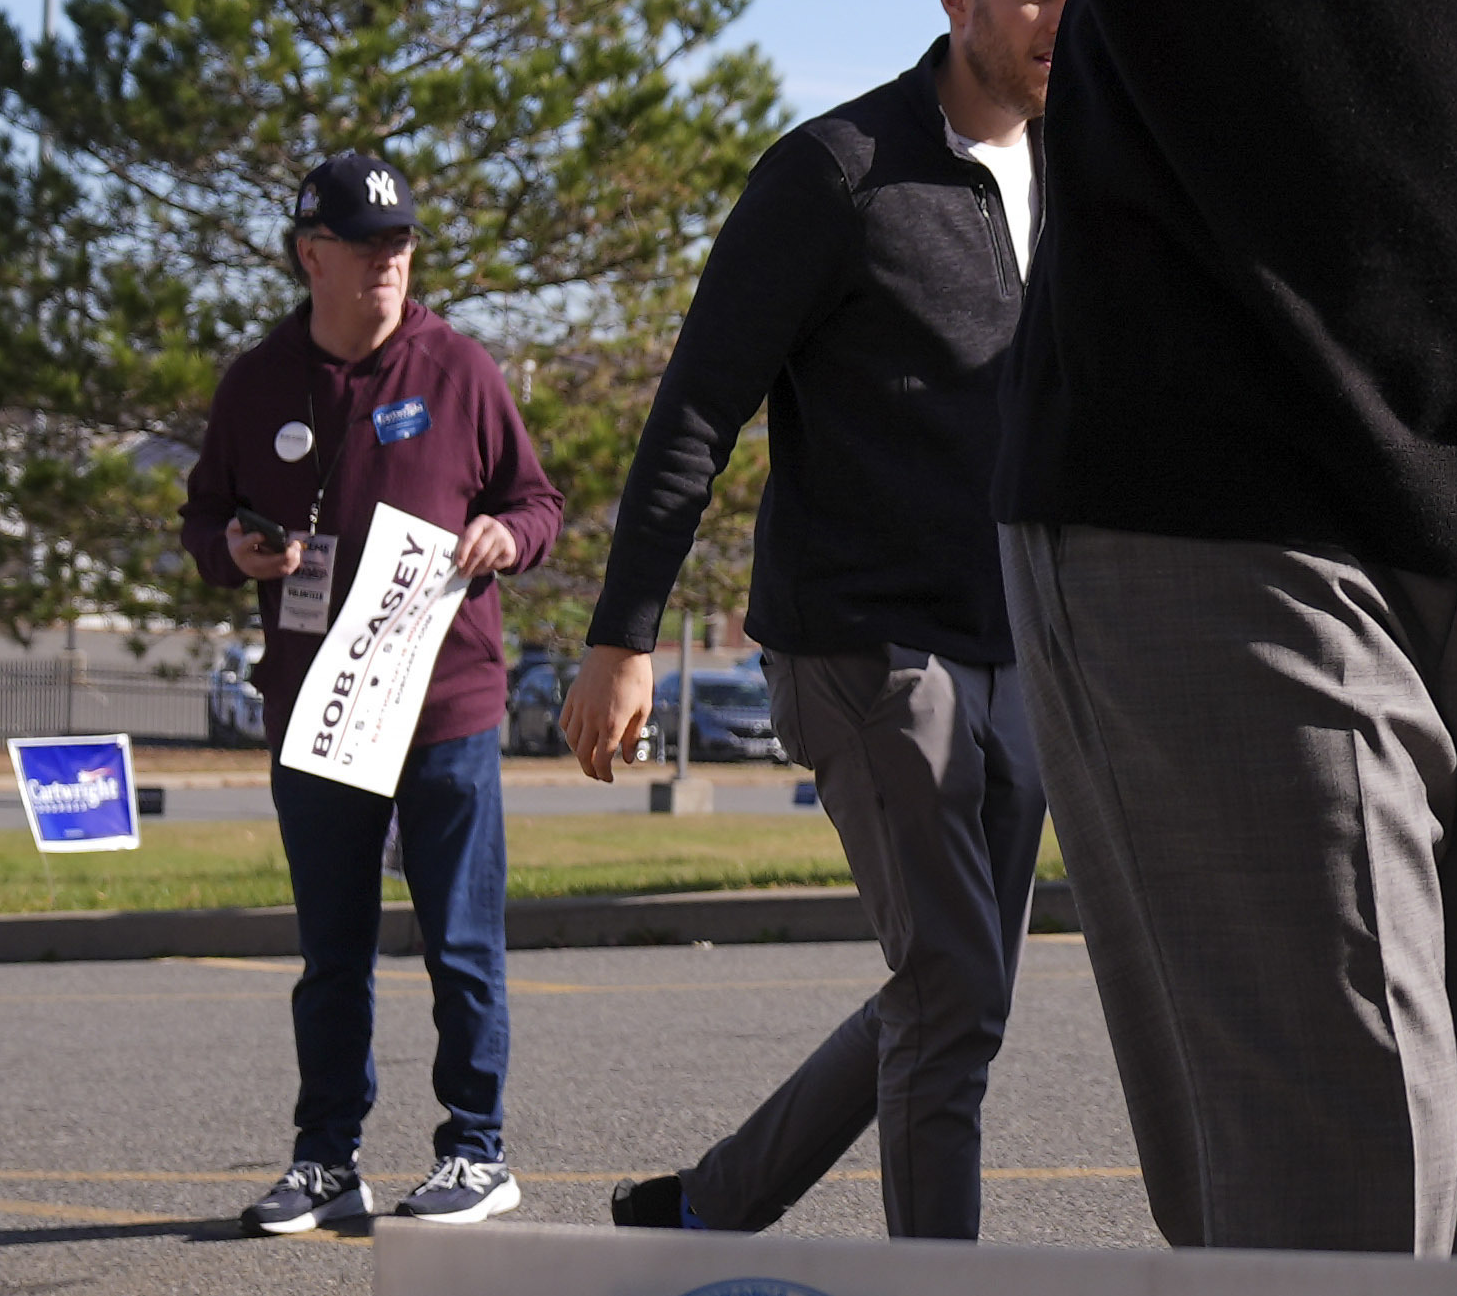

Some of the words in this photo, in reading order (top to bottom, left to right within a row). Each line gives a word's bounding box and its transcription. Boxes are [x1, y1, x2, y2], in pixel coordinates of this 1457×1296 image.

[365, 170, 398, 205] NY
[382, 548, 454, 654] SENATE
[310, 668, 356, 758] BOB
[348, 531, 424, 661] CASEY
[27, 776, 119, 809] Cartwright
